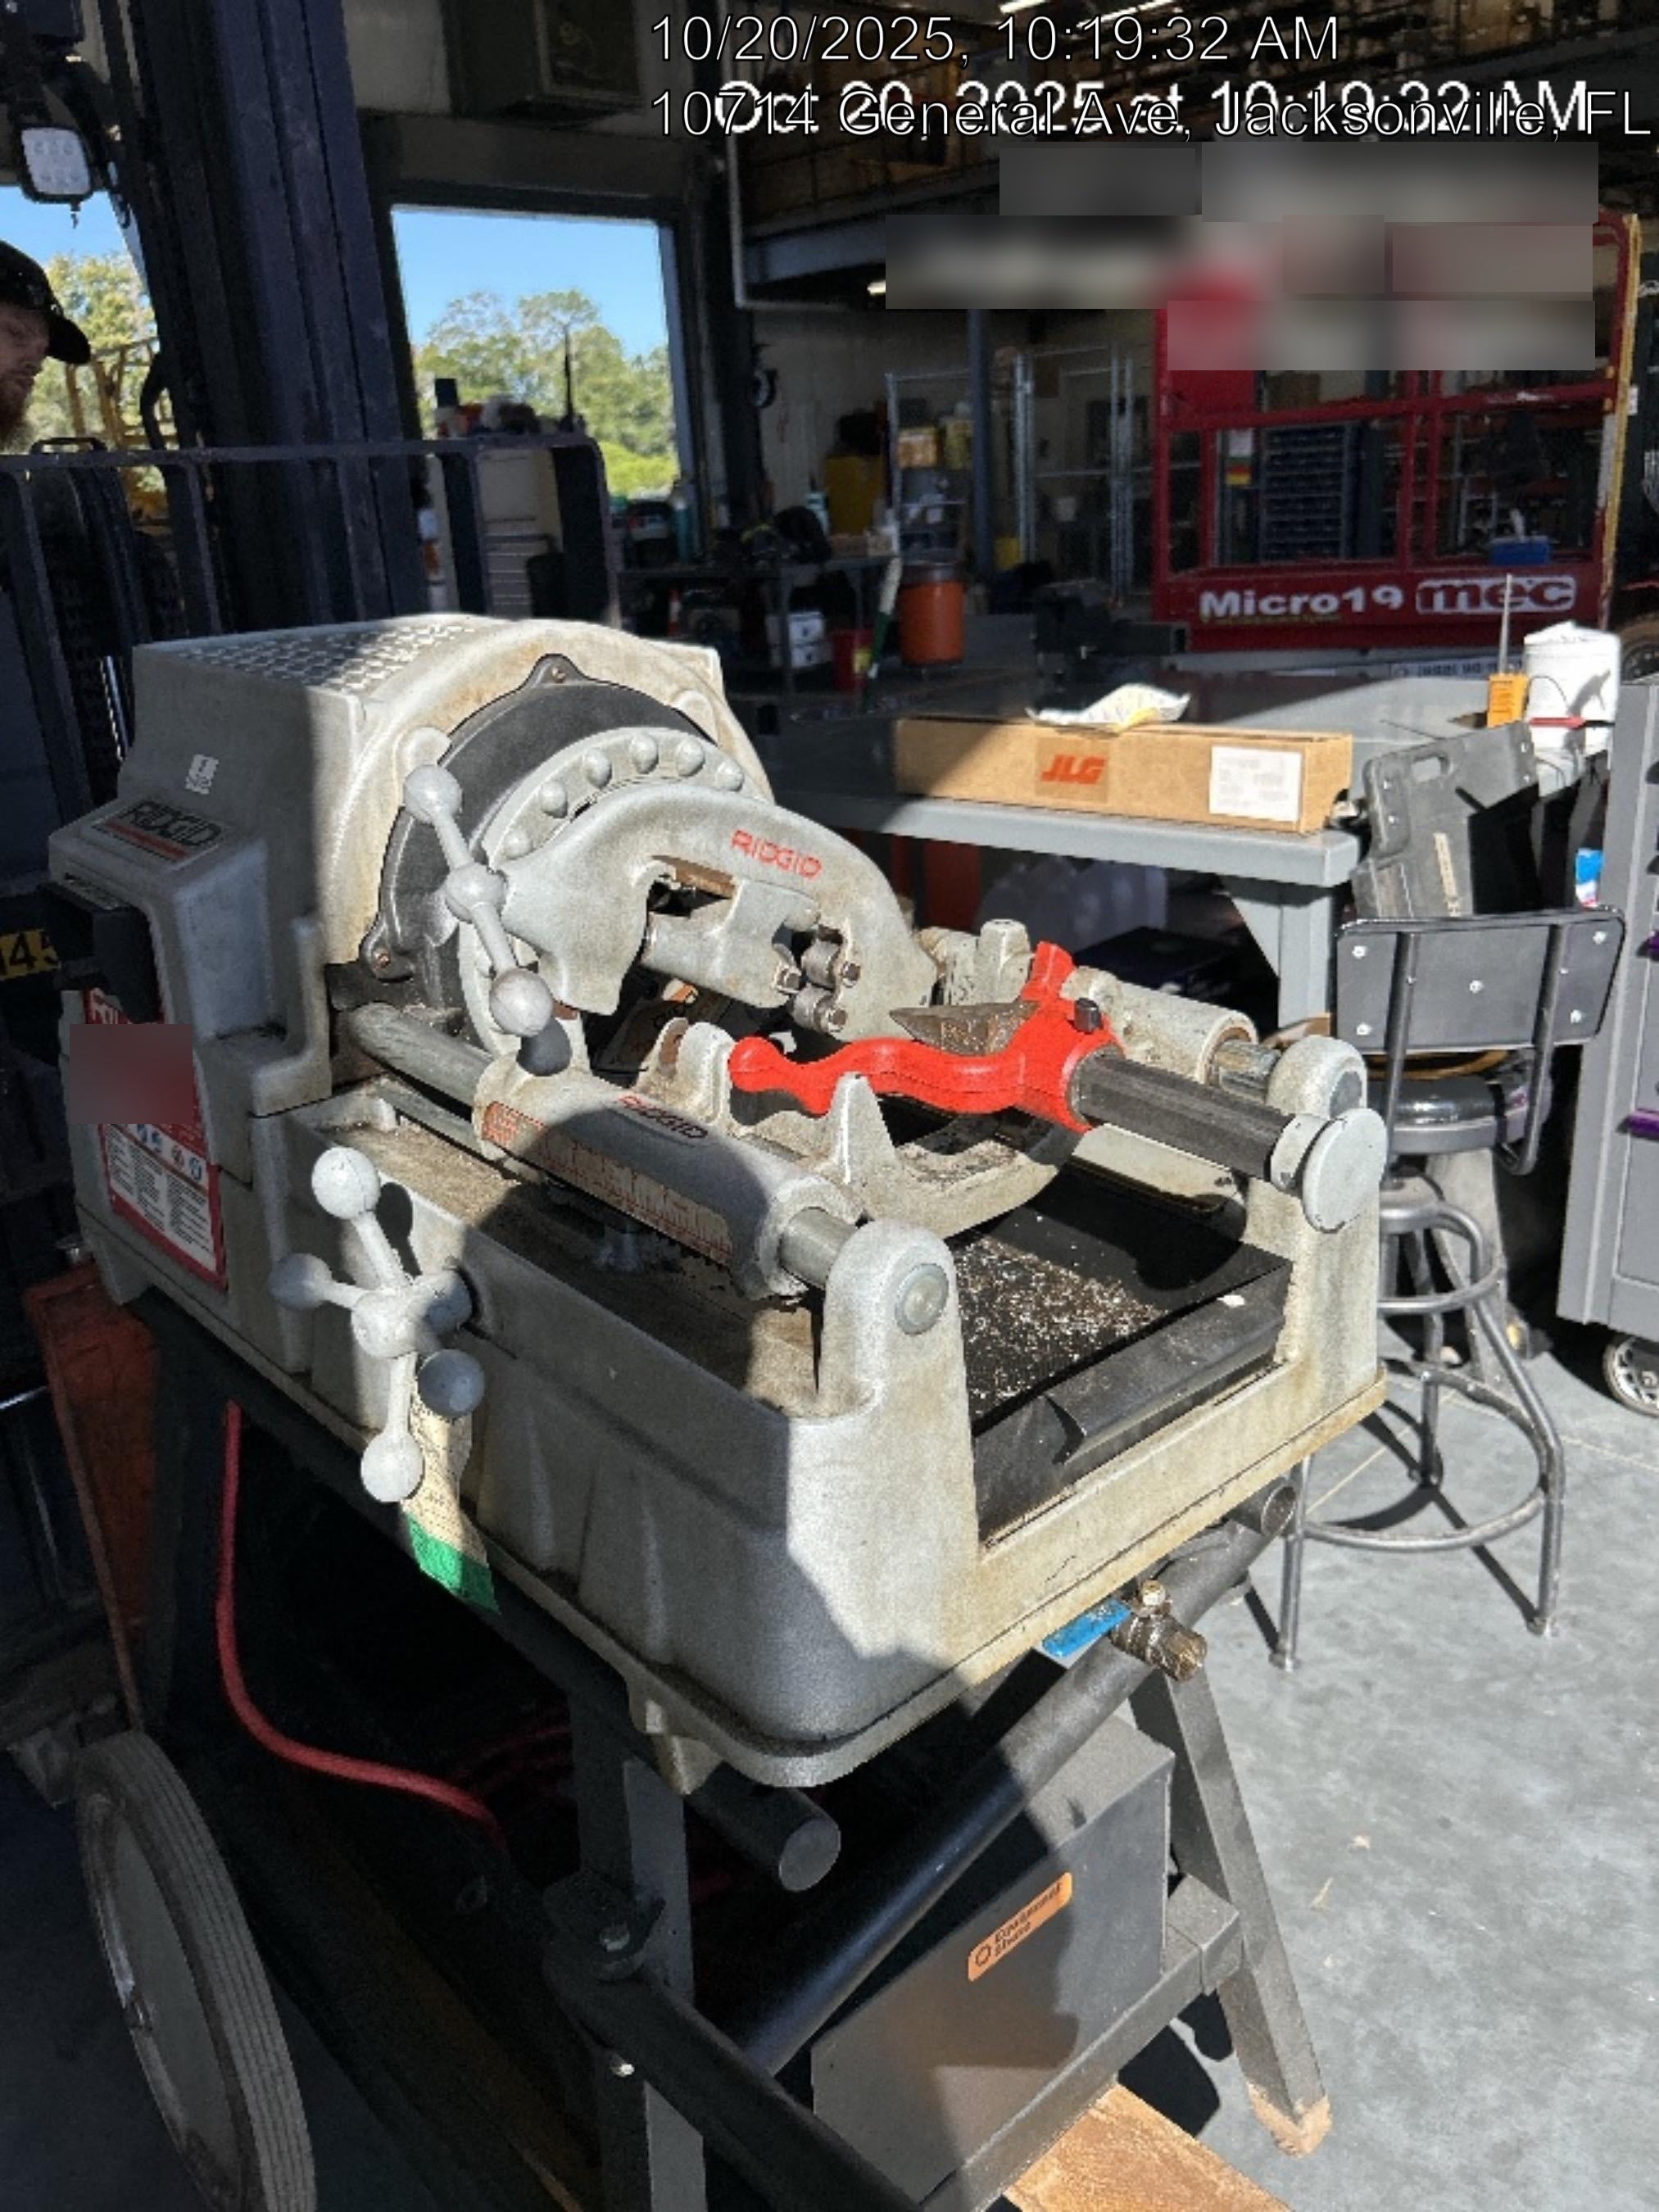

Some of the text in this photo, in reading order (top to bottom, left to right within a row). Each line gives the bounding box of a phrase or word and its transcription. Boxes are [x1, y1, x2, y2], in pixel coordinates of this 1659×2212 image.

[1199, 584, 1404, 619] Micro19
[1040, 754, 1108, 785] JLG
[732, 829, 823, 880] RIDGID
[618, 1095, 709, 1139] RIDGID
